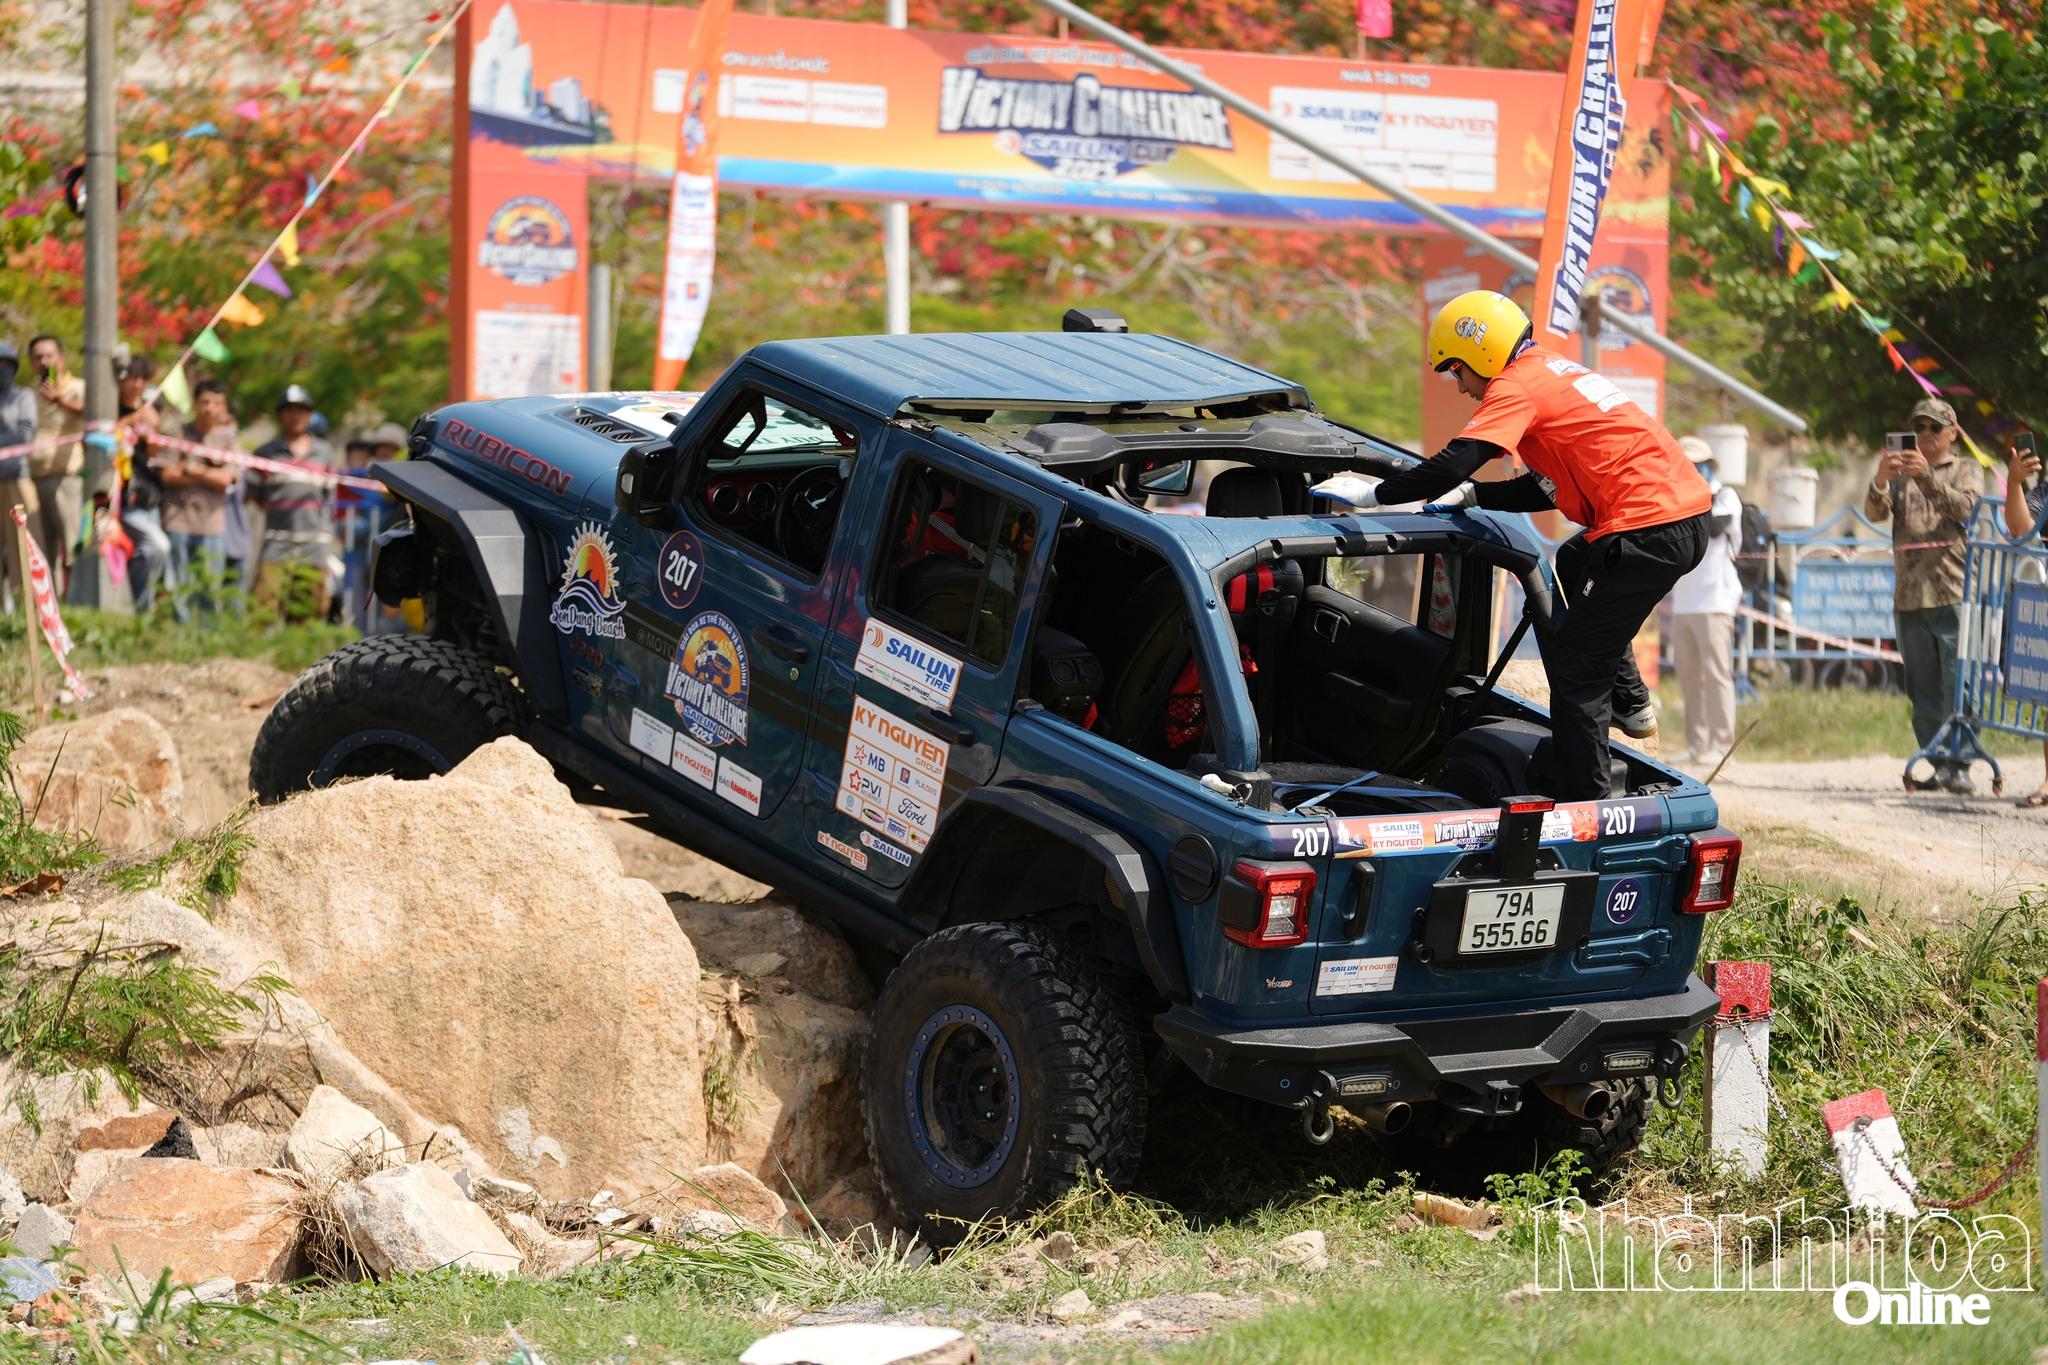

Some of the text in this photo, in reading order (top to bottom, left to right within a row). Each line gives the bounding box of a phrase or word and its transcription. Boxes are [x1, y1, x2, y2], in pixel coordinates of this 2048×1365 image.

[1300, 104, 1381, 123] SAILUN
[439, 418, 575, 496] RUBICON
[664, 550, 698, 591] 207
[594, 614, 627, 639] Beach
[886, 637, 957, 684] SAILUN
[925, 673, 951, 693] TIRE
[684, 704, 718, 734] SAILUN
[688, 722, 715, 745] 2025
[868, 753, 886, 772] MB
[861, 777, 882, 798] PVI
[898, 798, 928, 826] Ford
[1602, 805, 1636, 836] 207
[1382, 823, 1420, 832] SAILUN
[873, 839, 911, 866] SAILUN
[1291, 827, 1330, 857] 207
[1496, 891, 1534, 918] 79A
[1613, 891, 1638, 912] 207
[1471, 919, 1549, 949] 555.66
[1329, 965, 1359, 973] SAILUN
